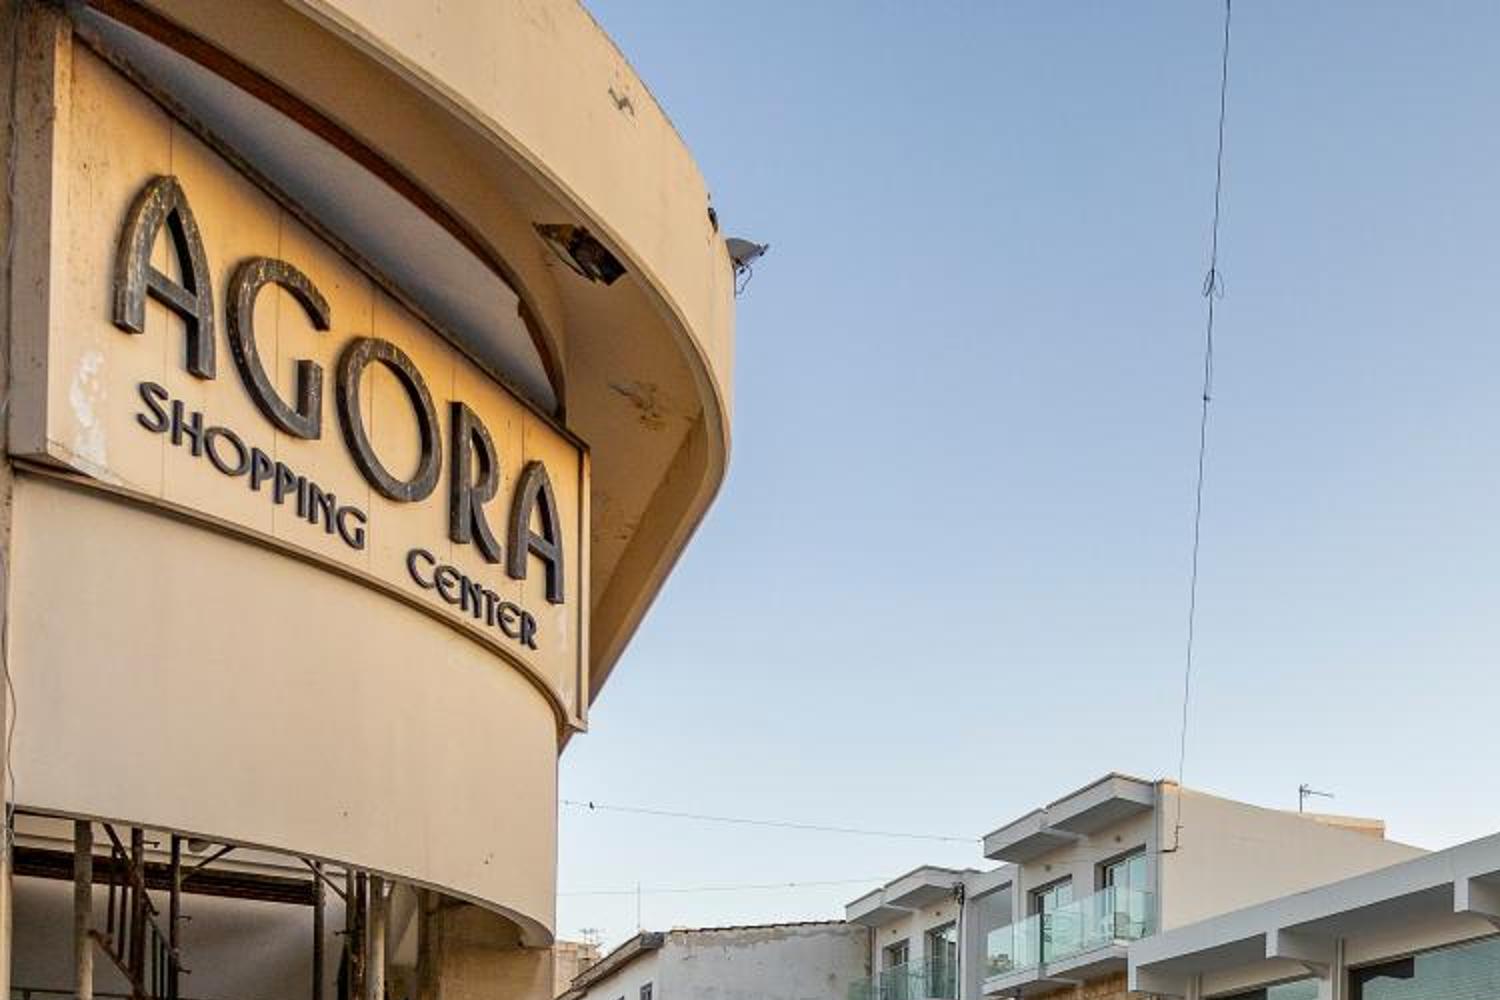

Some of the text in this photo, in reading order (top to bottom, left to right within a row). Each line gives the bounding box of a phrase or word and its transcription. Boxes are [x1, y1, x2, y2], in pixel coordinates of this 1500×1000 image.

[113, 175, 565, 605] AGORA
[136, 382, 537, 650] SHOPPING CENTER
